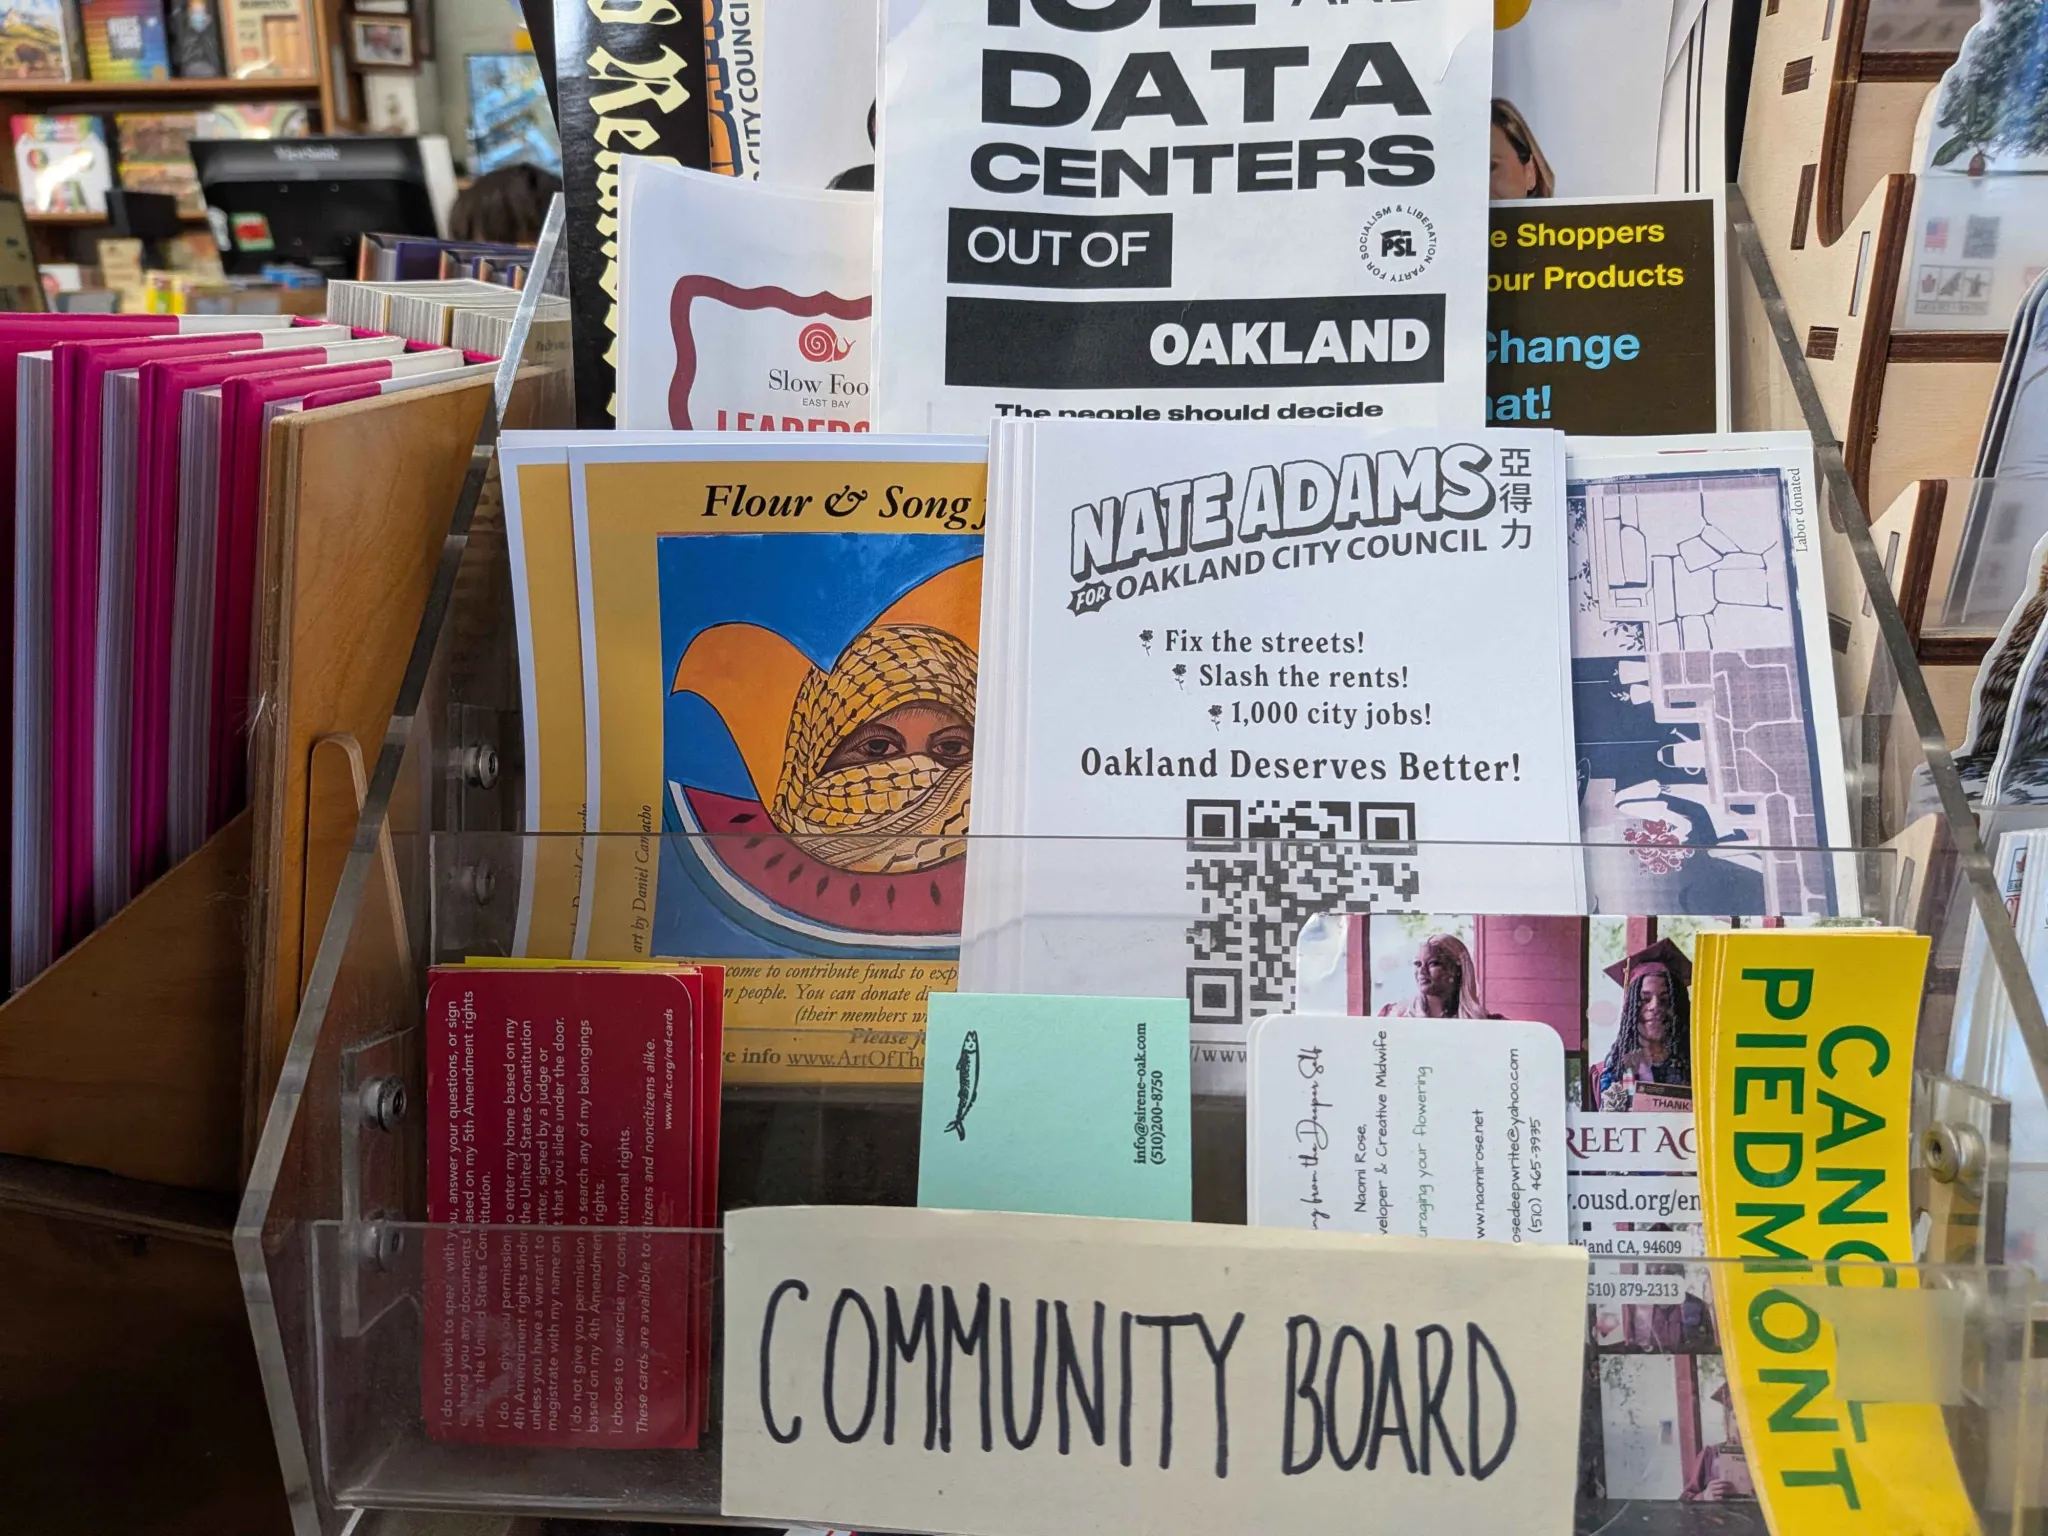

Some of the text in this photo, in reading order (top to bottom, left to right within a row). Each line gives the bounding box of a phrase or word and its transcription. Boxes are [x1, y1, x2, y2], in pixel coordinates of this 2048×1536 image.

[981, 41, 1432, 131] DATA
[970, 134, 1435, 198] CENTERS
[967, 226, 1150, 267] OUT OF
[1359, 204, 1437, 282] PARTY FOR SOCIALISM & LIBERATION
[1381, 236, 1417, 257] PSL
[1517, 223, 1665, 250] Shoppers
[1545, 263, 1684, 291] Products
[1150, 319, 1430, 366] OAKLAND
[769, 369, 823, 394] Slow
[802, 398, 851, 408] EAST BAY
[1168, 404, 1270, 421] should
[1277, 402, 1384, 419] decide
[701, 484, 812, 519] Flour
[824, 485, 868, 518] &
[879, 485, 972, 530] Song
[1070, 442, 1497, 581] NATE ADAMS
[1499, 448, 1532, 550] 亞得力
[1787, 467, 1809, 552] Labor donated
[1073, 529, 1488, 614] FOR OAKLAND CITY COUNCIL
[1165, 629, 1365, 654] Fix the streets!
[1199, 664, 1409, 689] Slash the rents!
[1231, 701, 1432, 730] 1,000 city jobs!
[1081, 746, 1522, 782] Oakland Deserves Better!
[632, 867, 648, 911] Daniel
[630, 916, 649, 930] by
[632, 932, 643, 953] art
[734, 984, 787, 1004] people.
[796, 984, 824, 1000] You
[830, 988, 855, 1000] can
[861, 987, 911, 1001] donate
[766, 965, 780, 978] to
[785, 965, 859, 979] contribute
[862, 965, 905, 984] funds
[910, 967, 924, 979] to
[794, 1005, 836, 1025] (their
[840, 1009, 908, 1023] members
[539, 1047, 548, 1062] or
[642, 1038, 656, 1073] alike.
[741, 1048, 781, 1064] info
[849, 1028, 908, 1045] Please
[577, 1020, 593, 1094] belongings
[663, 1008, 676, 1129] www.ilrc.org/red-cards
[1298, 1045, 1324, 1079] Self
[1372, 1030, 1387, 1088] Midwife
[445, 1001, 461, 1204] answer your questions, or sign
[461, 991, 478, 1187] on my 5th Amendment rights
[536, 1066, 552, 1105] judge
[1133, 1022, 1147, 1165] info@sirene-oak.com
[1412, 1065, 1433, 1137] flowering
[1652, 1098, 1690, 1110] THANK
[503, 1018, 519, 1210] enter my home based on my
[519, 1020, 532, 1198] United States Constitution
[540, 1108, 548, 1116] a
[580, 1098, 592, 1118] my
[642, 1076, 655, 1152] noncitizens
[1150, 1070, 1167, 1165] (510)200-8750
[1295, 1080, 1333, 1150] Deeper
[1375, 1094, 1388, 1157] Creative
[536, 1120, 551, 1136] by
[576, 1122, 589, 1136] of
[536, 1141, 551, 1185] signed
[580, 1140, 592, 1164] any
[641, 1156, 654, 1182] and
[1298, 1144, 1317, 1168] the
[1374, 1163, 1388, 1174] &
[1418, 1144, 1433, 1178] your
[576, 1168, 589, 1212] search
[1300, 1170, 1323, 1204] from
[1354, 1169, 1367, 1212] Naomi
[1528, 1117, 1542, 1233] (510) 465-3935
[592, 1180, 608, 1222] rights.
[546, 1017, 567, 1431] magistrate with that you slide under the door.
[1733, 968, 1861, 1512] PIEDMONT
[1617, 1240, 1640, 1255] CA,
[1643, 1240, 1682, 1254] 94609
[611, 1126, 633, 1426] choose rights.
[1619, 1283, 1679, 1296] 879-2313
[635, 1353, 649, 1390] cards
[759, 1279, 1518, 1481] COMMUNITY BOARD
[635, 1394, 649, 1433] These
